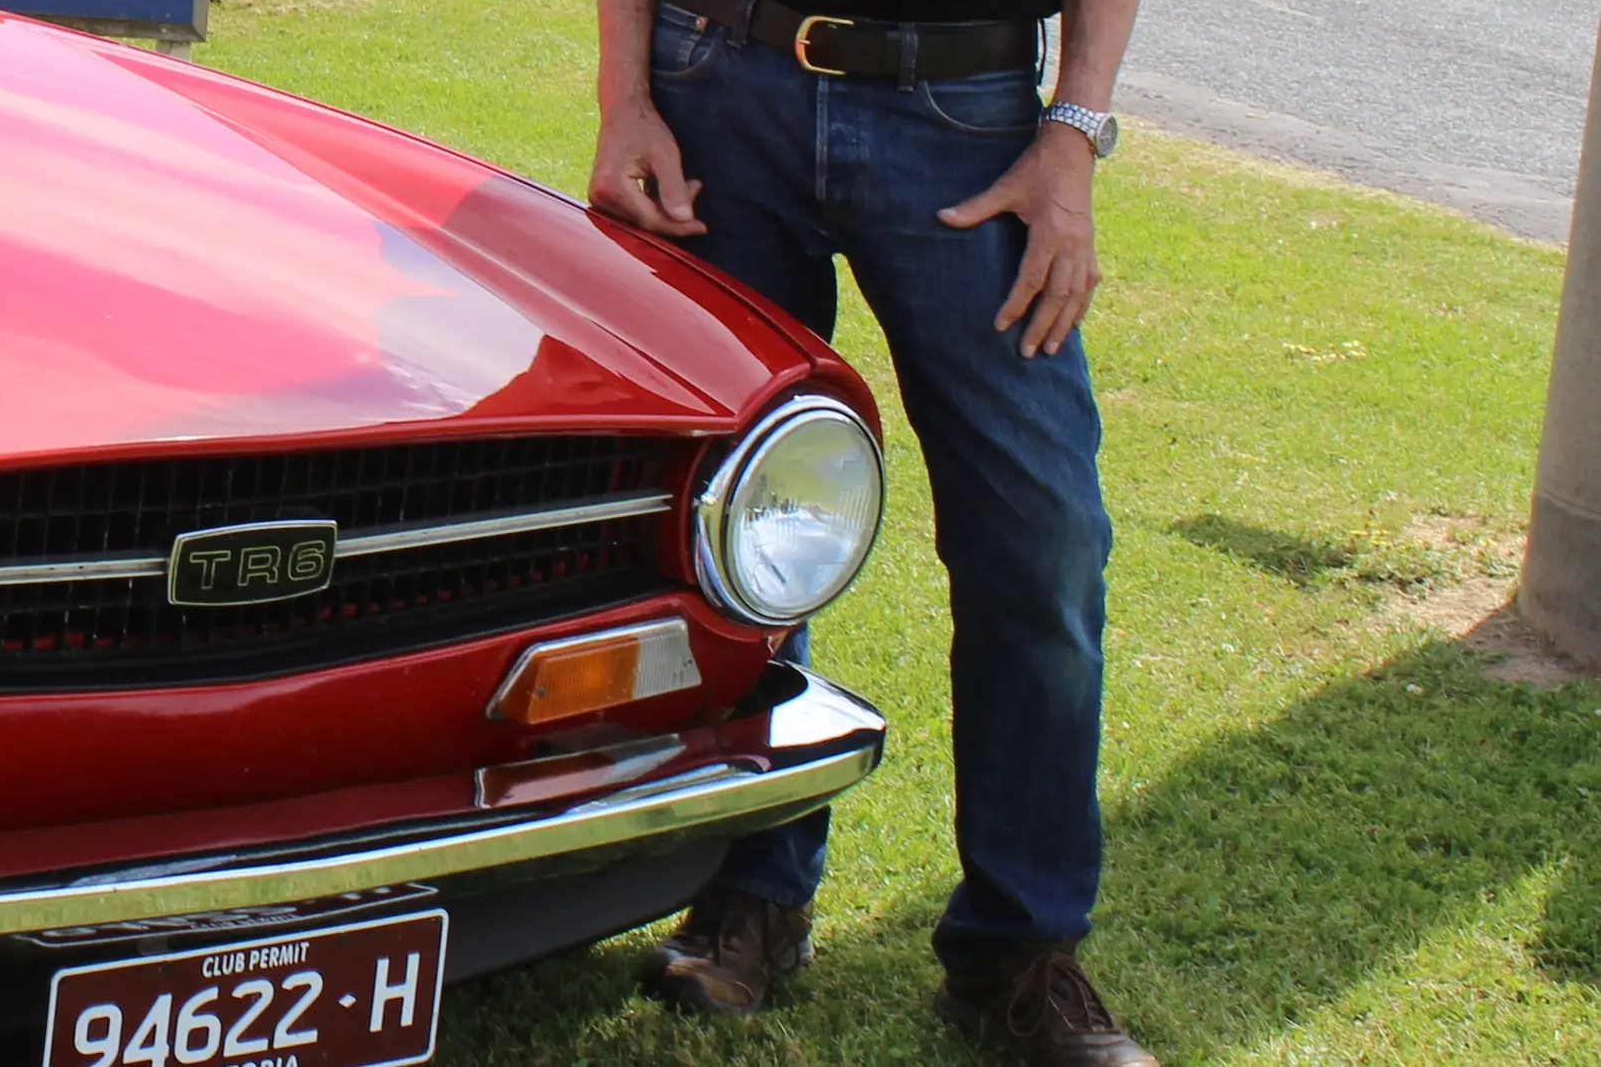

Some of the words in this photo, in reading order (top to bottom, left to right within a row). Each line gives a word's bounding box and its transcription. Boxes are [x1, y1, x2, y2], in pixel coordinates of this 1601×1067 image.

[190, 540, 326, 589] TR6
[202, 954, 245, 978] CLUB
[249, 941, 310, 971] PERMIT
